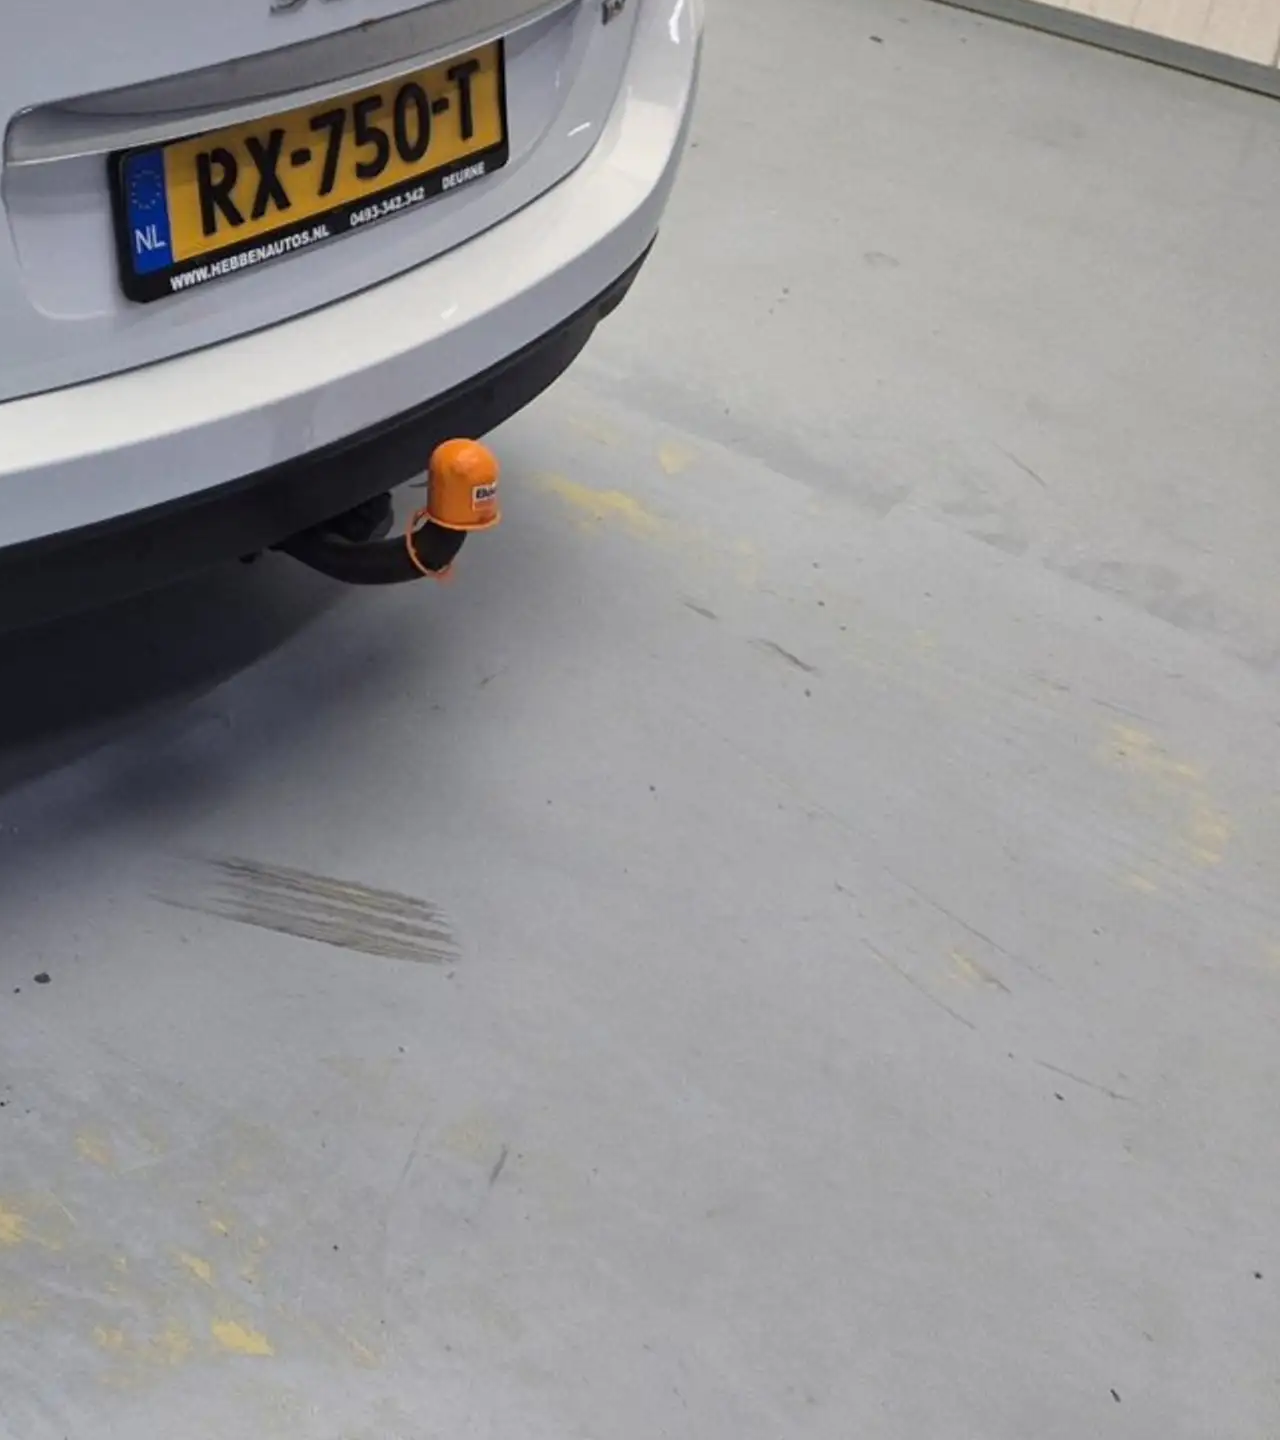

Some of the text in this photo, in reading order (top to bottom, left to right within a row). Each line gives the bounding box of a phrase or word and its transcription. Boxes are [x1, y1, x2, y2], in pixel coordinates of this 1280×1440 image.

[195, 59, 481, 238] RX-750-T
[134, 224, 166, 254] NL
[170, 224, 329, 291] WWW.HEBBENAUTOS.NL
[441, 160, 486, 191] DEURNE
